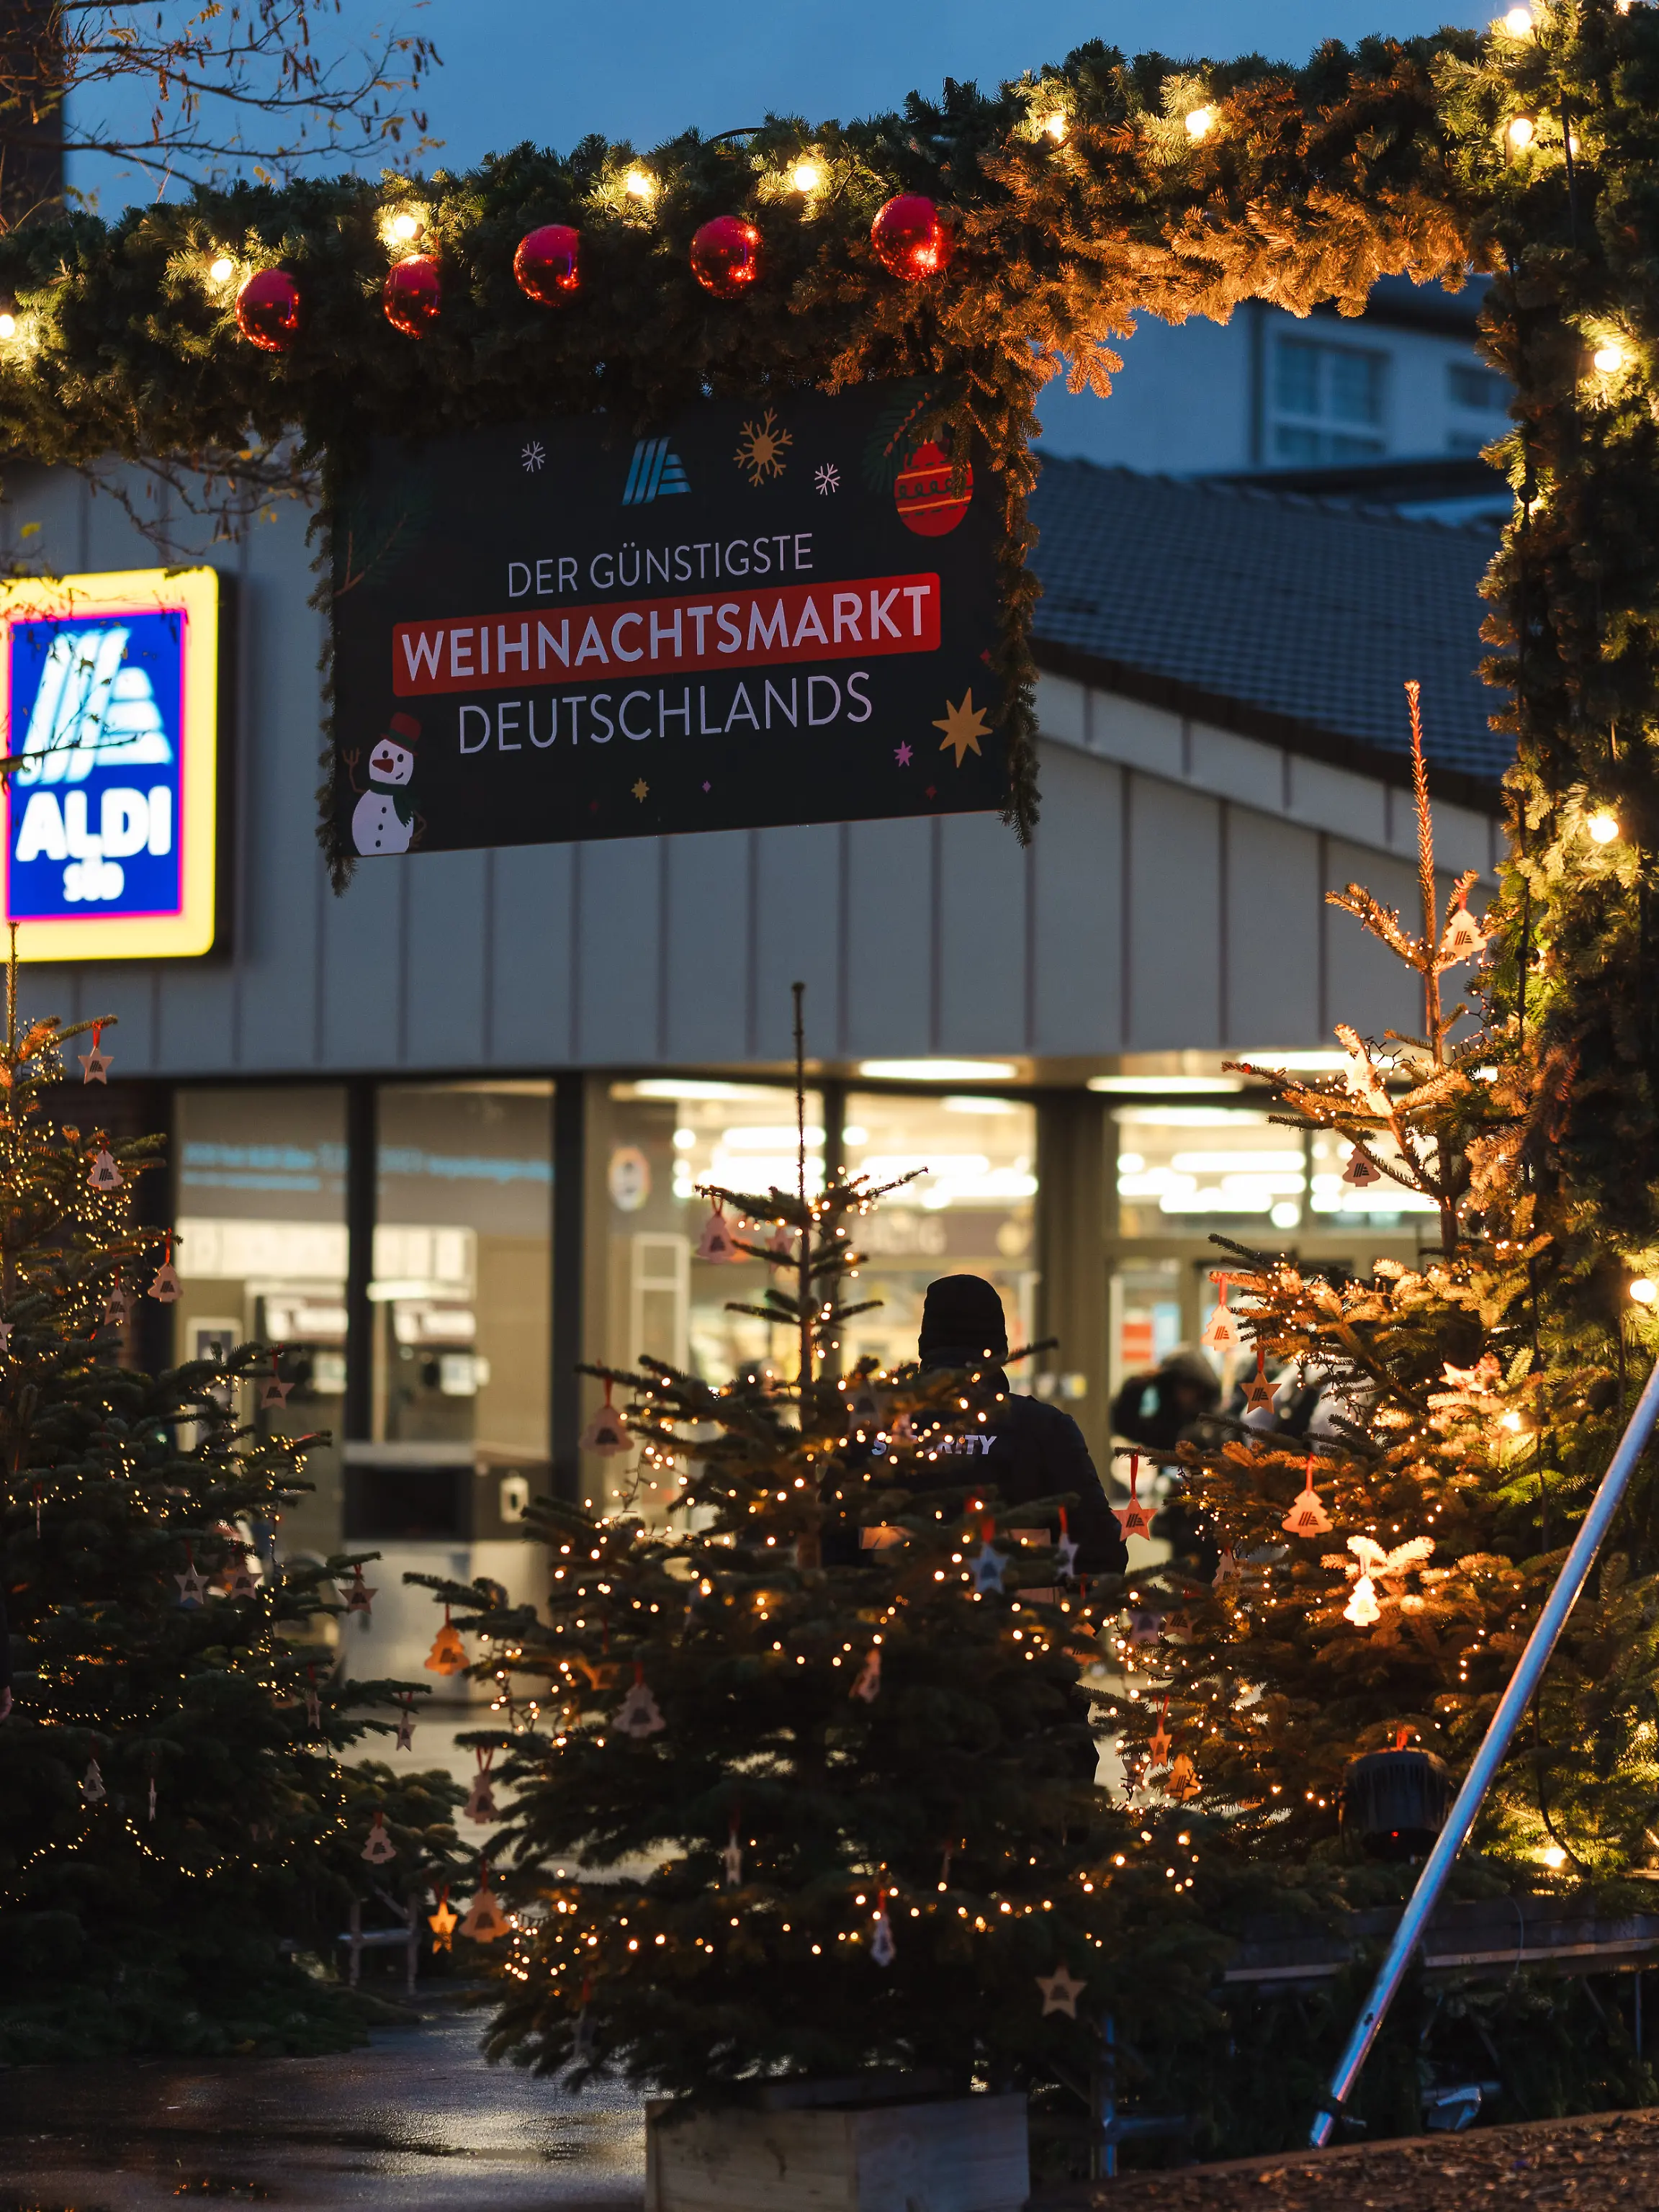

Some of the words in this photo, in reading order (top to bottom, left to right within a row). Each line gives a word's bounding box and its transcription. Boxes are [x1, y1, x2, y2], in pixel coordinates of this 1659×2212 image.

[508, 557, 578, 598] DER
[590, 533, 813, 589] GÜNSTIGSTE
[401, 585, 931, 681] WEIHNACHTSMARKT
[459, 671, 872, 754] DEUTSCHLANDS
[15, 786, 172, 862] ALDI
